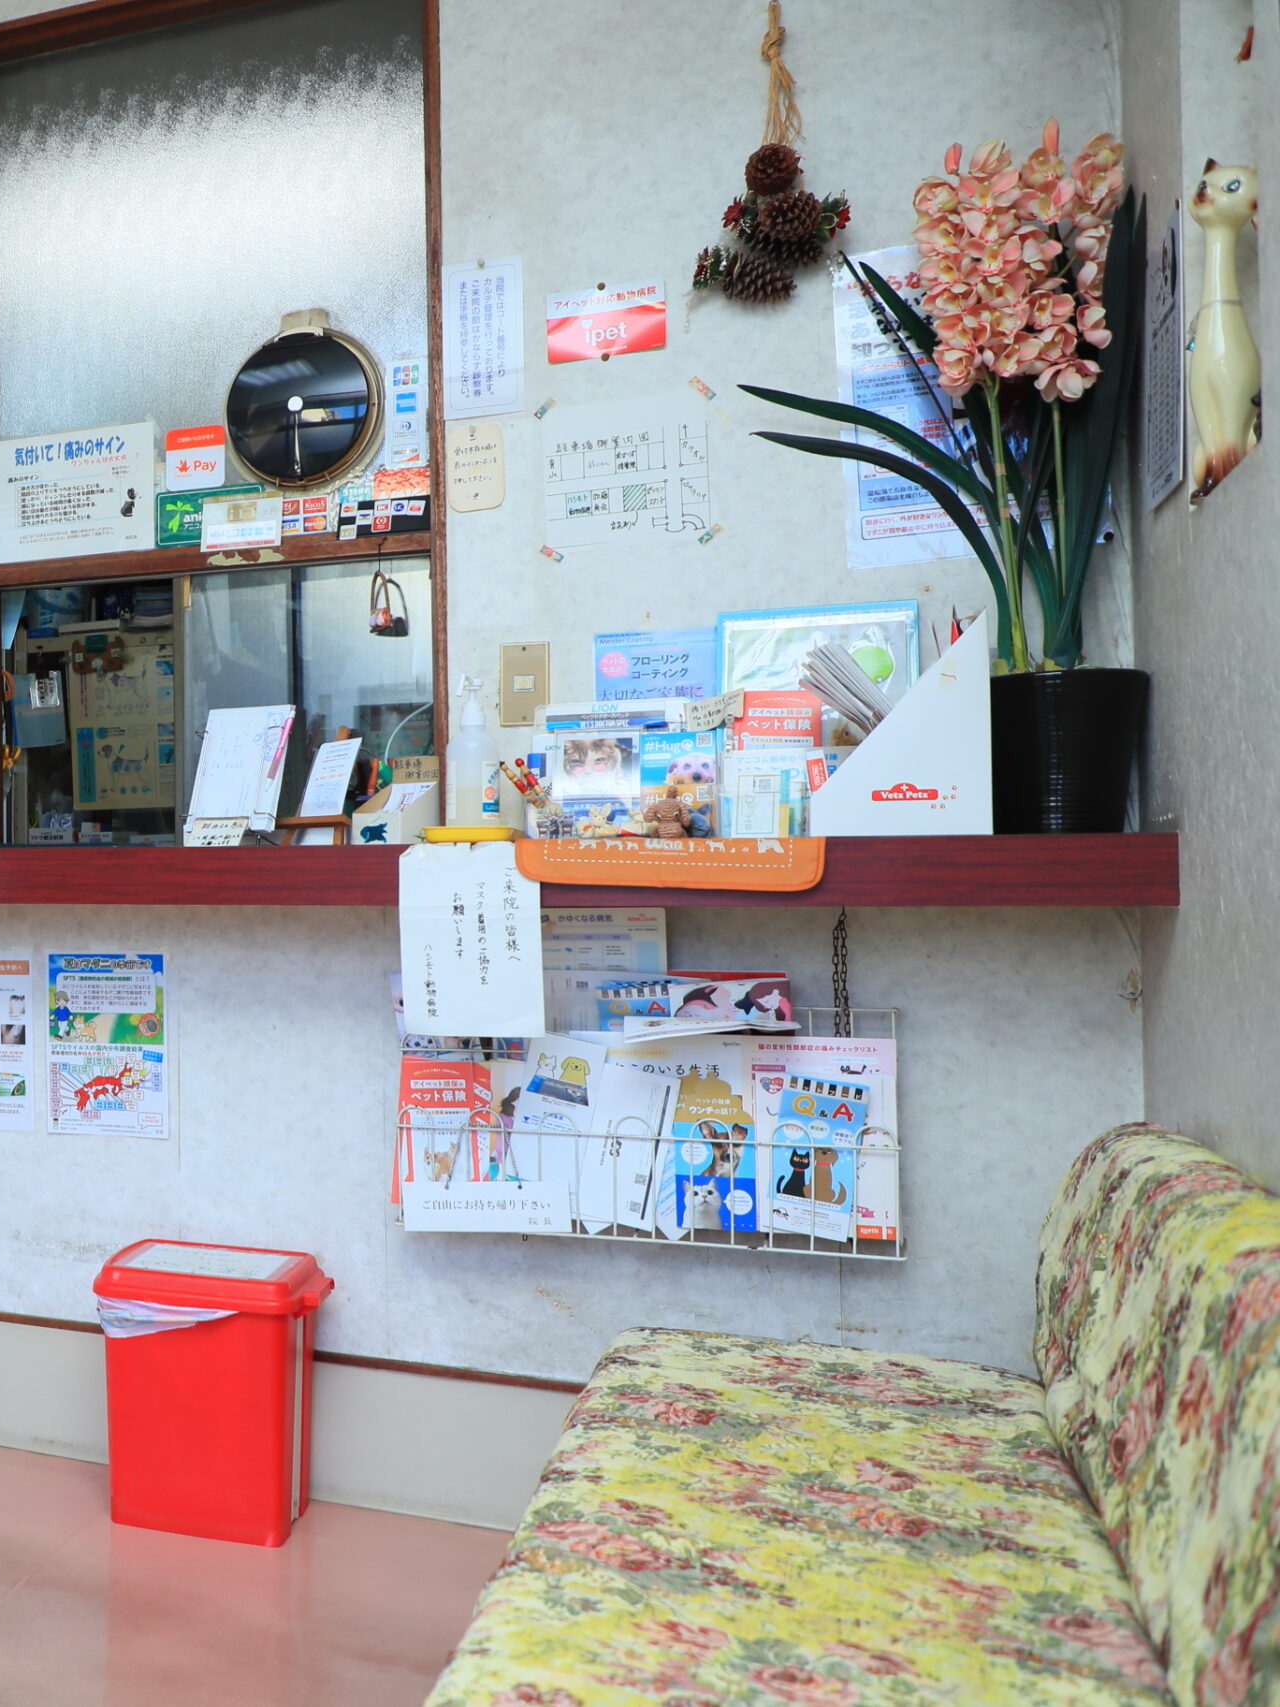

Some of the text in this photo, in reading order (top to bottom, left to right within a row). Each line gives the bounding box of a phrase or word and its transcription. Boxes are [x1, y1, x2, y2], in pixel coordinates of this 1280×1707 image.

[554, 286, 657, 310] アイペット対応動物病院
[581, 319, 627, 346] ipet
[555, 432, 650, 453] 駐車場御案内図
[193, 460, 217, 473] Pay
[631, 653, 690, 666] フローリング
[631, 667, 689, 679] コーティング
[592, 704, 618, 712] LION
[747, 719, 812, 730] ペット保険
[503, 867, 521, 962] ご来院の皆様へ
[558, 914, 613, 922] かゆくなる病気
[452, 892, 465, 960] お願いします
[476, 881, 490, 985] マスク着用のご協力を
[424, 944, 438, 1017] ハシモト動物病院
[609, 1000, 631, 1015] Q
[648, 1000, 666, 1014] A
[758, 1043, 878, 1054] 猫の変形性関節症の痛みチェックリスト
[411, 1090, 467, 1102] ペット保険
[792, 1096, 816, 1117] Q
[831, 1103, 853, 1121] A
[422, 1200, 551, 1210] ご自由にお持ち帰り下さい
